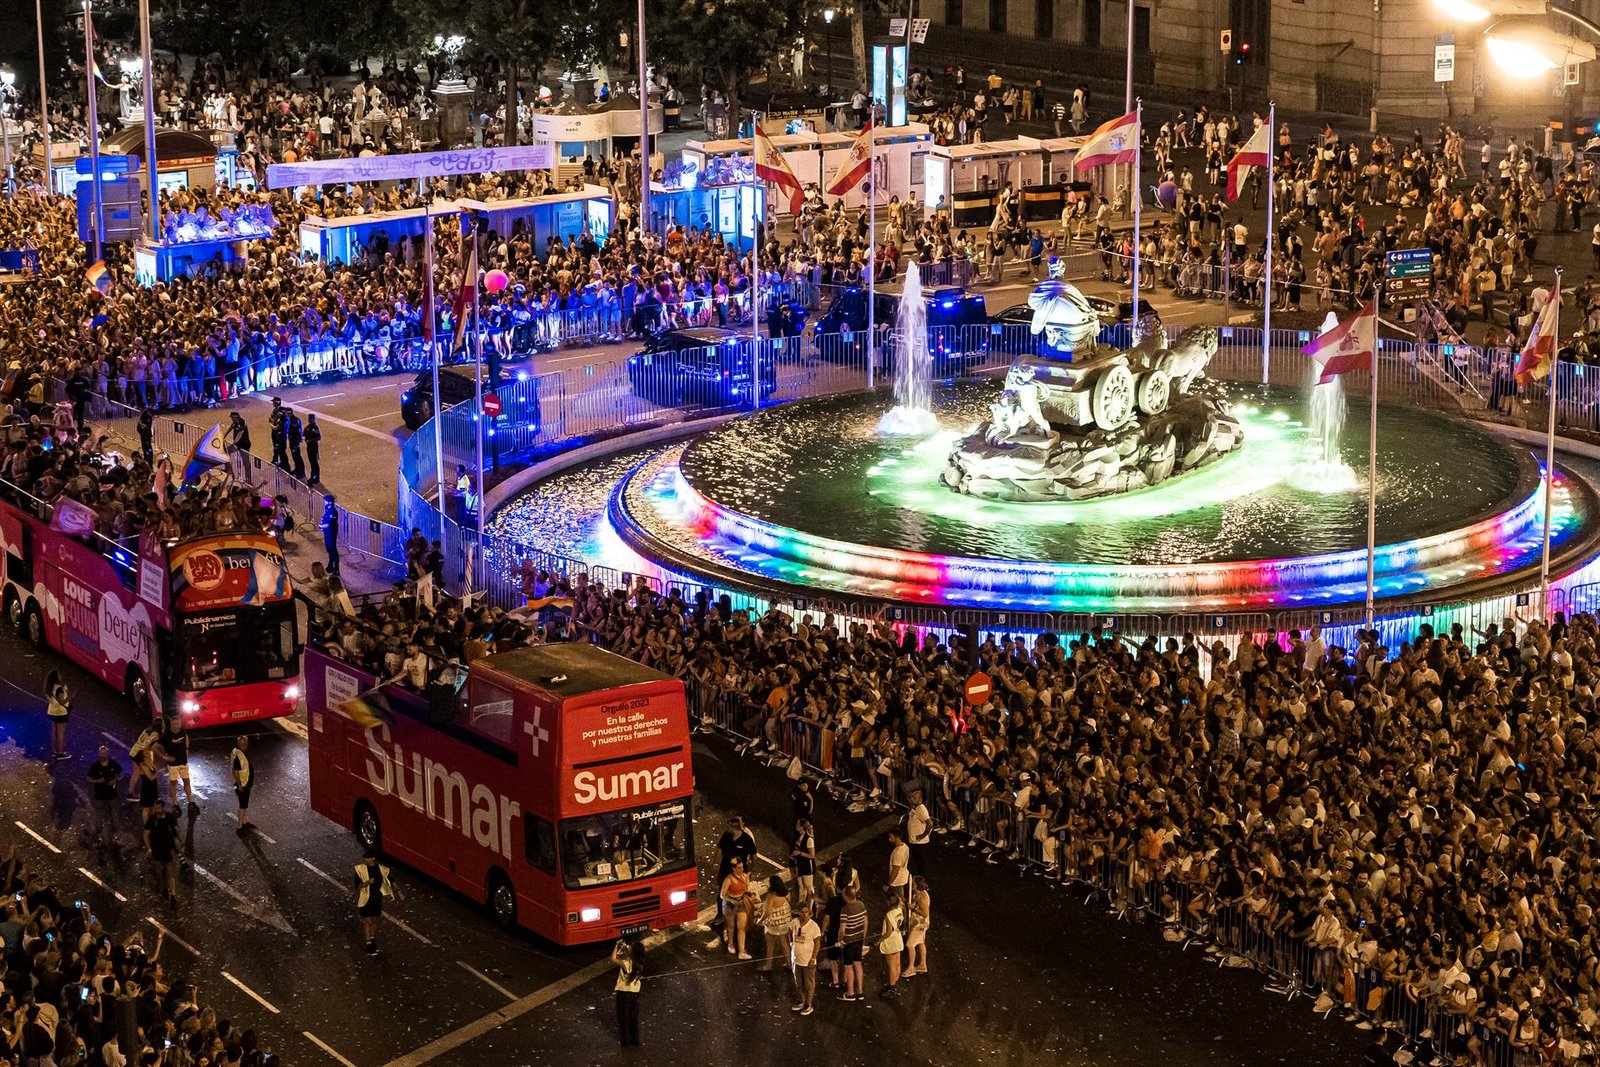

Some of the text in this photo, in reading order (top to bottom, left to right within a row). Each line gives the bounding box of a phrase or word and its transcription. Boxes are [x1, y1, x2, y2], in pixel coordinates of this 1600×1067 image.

[64, 577, 92, 610] LOVE
[601, 698, 650, 714] Orgullo 2023
[582, 717, 669, 741] por nuestros derechos
[606, 712, 645, 725] En la calle
[592, 727, 663, 748] y nuestras familias
[365, 720, 520, 867] Sumar
[574, 763, 684, 804] Sumar
